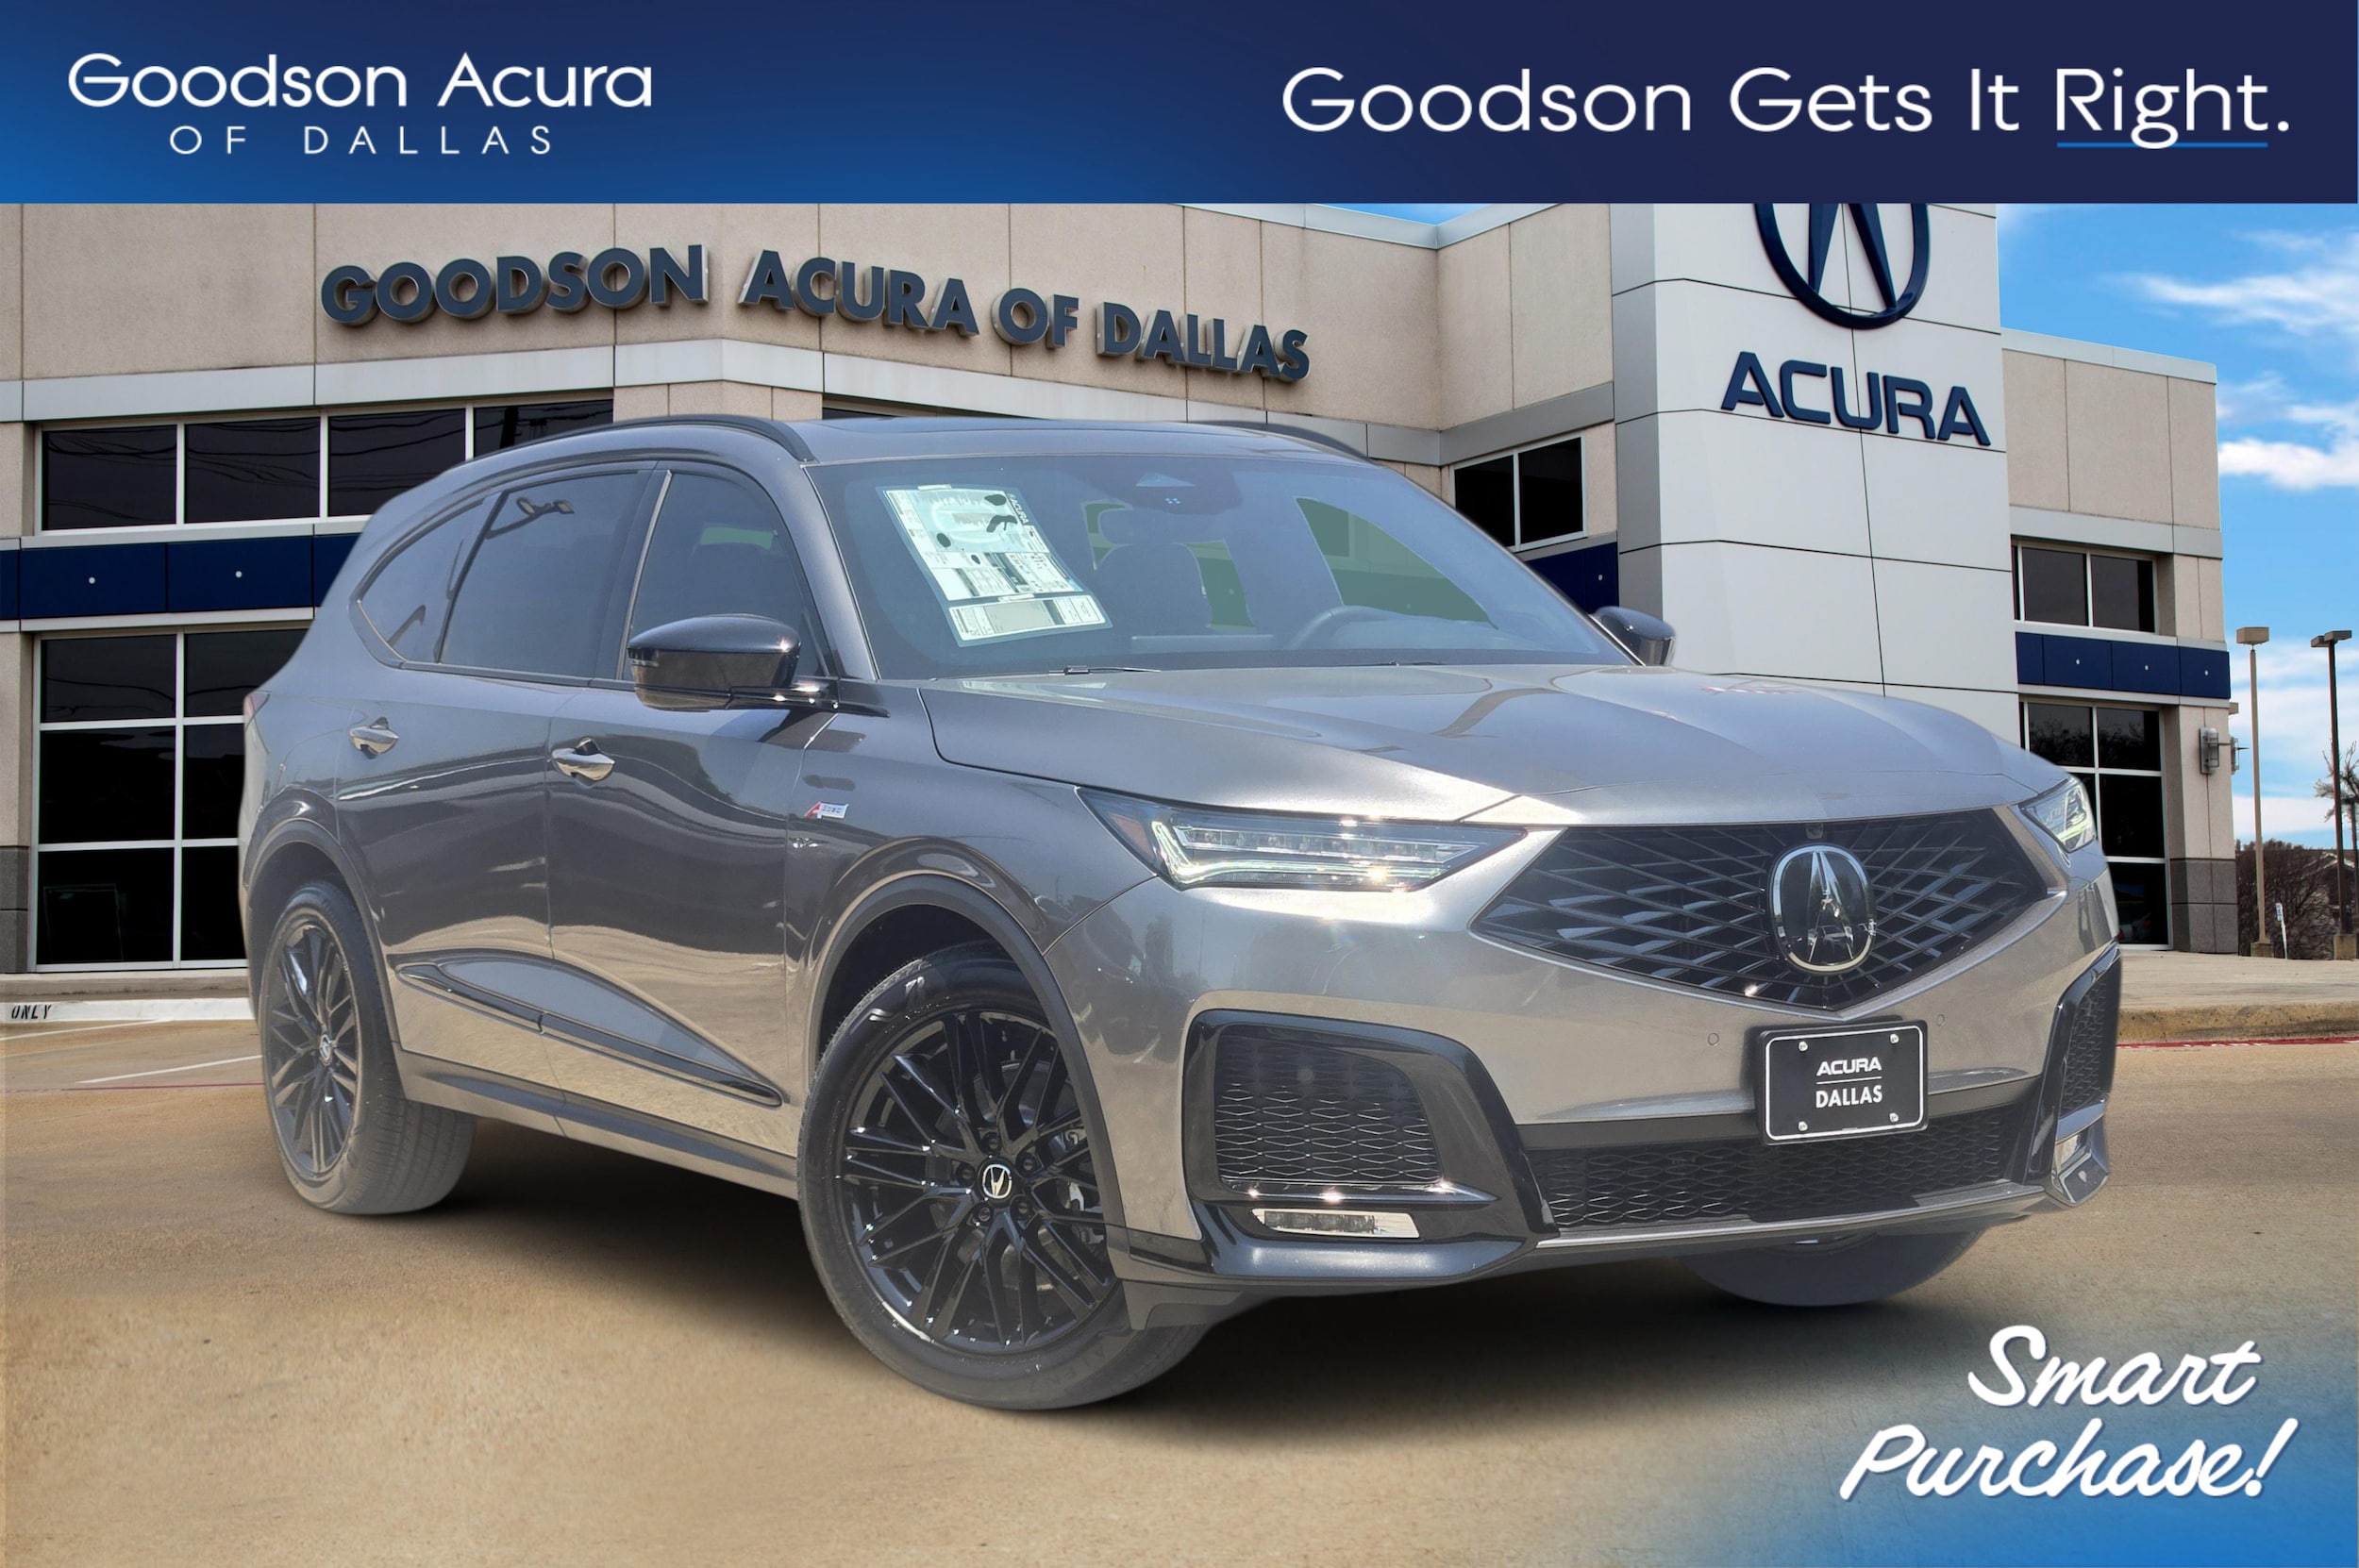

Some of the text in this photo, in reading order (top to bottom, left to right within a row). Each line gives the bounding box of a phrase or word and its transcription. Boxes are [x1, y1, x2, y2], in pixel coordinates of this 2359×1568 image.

[321, 243, 1312, 382] GOODSON ACURA OF DALLAS
[1720, 351, 1992, 446] ACURA
[10, 1004, 52, 1020] ONLY
[1816, 1057, 1882, 1076] ACURA
[1815, 1084, 1883, 1109] DALLAS
